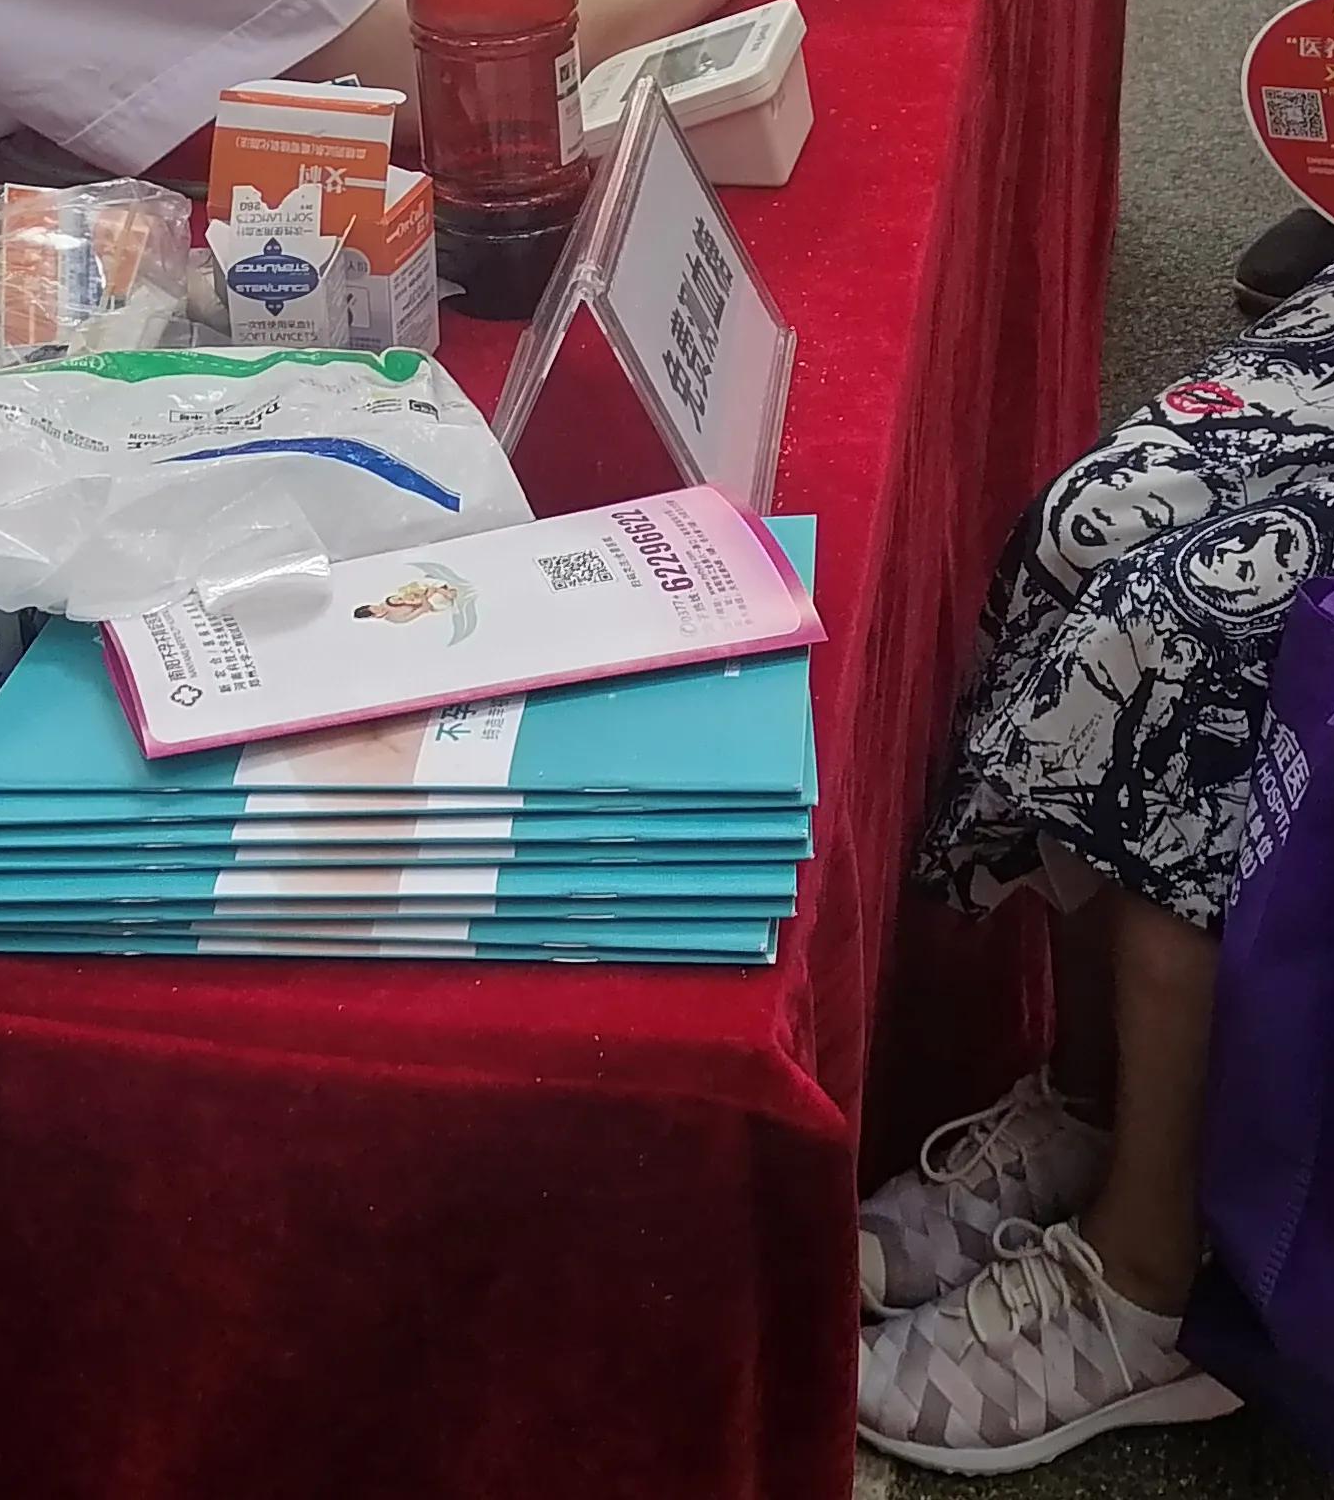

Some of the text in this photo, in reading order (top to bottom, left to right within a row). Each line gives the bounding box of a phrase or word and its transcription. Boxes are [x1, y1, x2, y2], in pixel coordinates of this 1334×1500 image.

[661, 215, 735, 435] 免费测血糖
[611, 508, 694, 592] 62296622
[1256, 761, 1291, 846] HOSPITA
